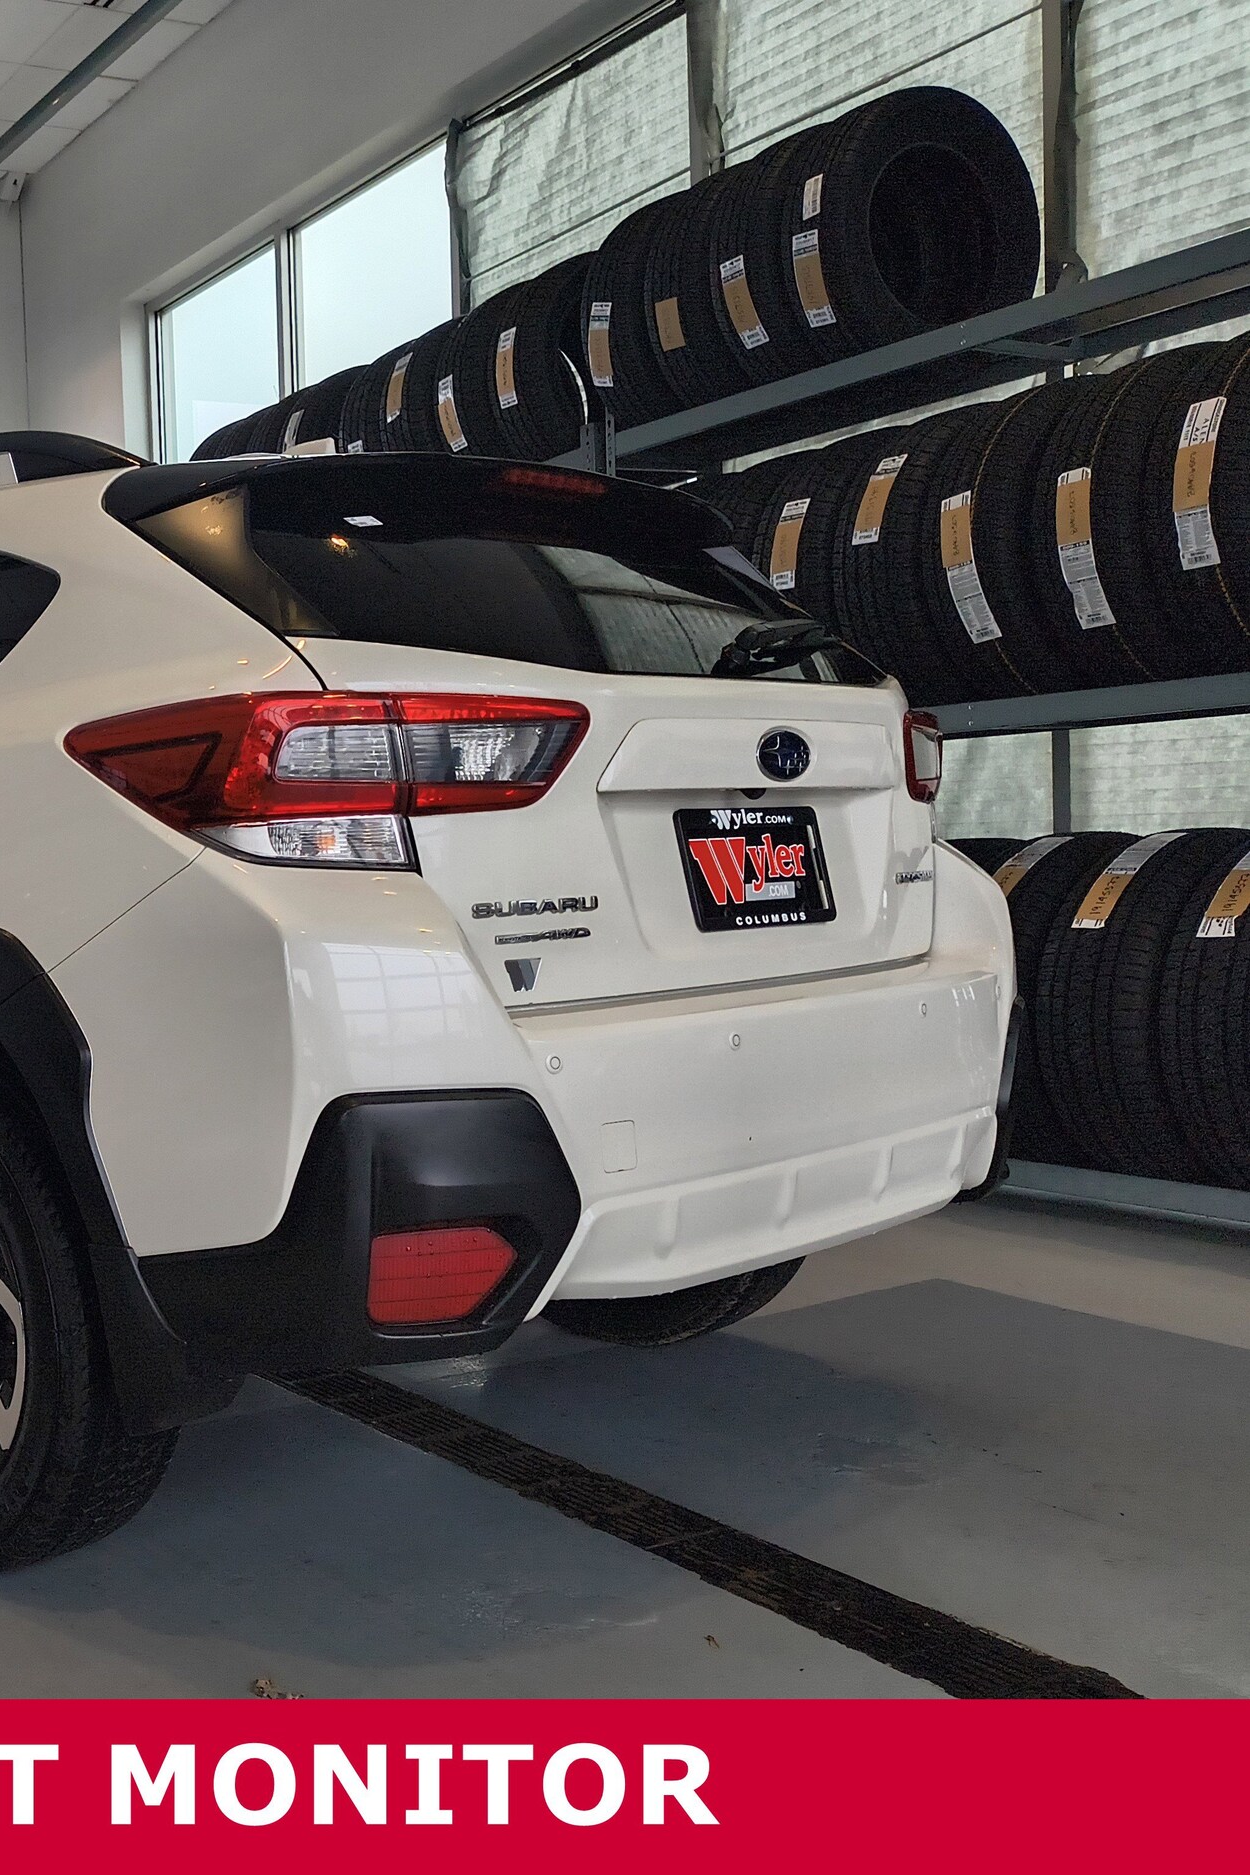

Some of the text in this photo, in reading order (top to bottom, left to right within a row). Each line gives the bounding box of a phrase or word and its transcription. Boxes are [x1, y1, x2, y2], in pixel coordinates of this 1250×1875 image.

[688, 833, 807, 906] Wyler
[471, 895, 599, 919] SUBARU
[735, 911, 807, 926] COLUMBUS
